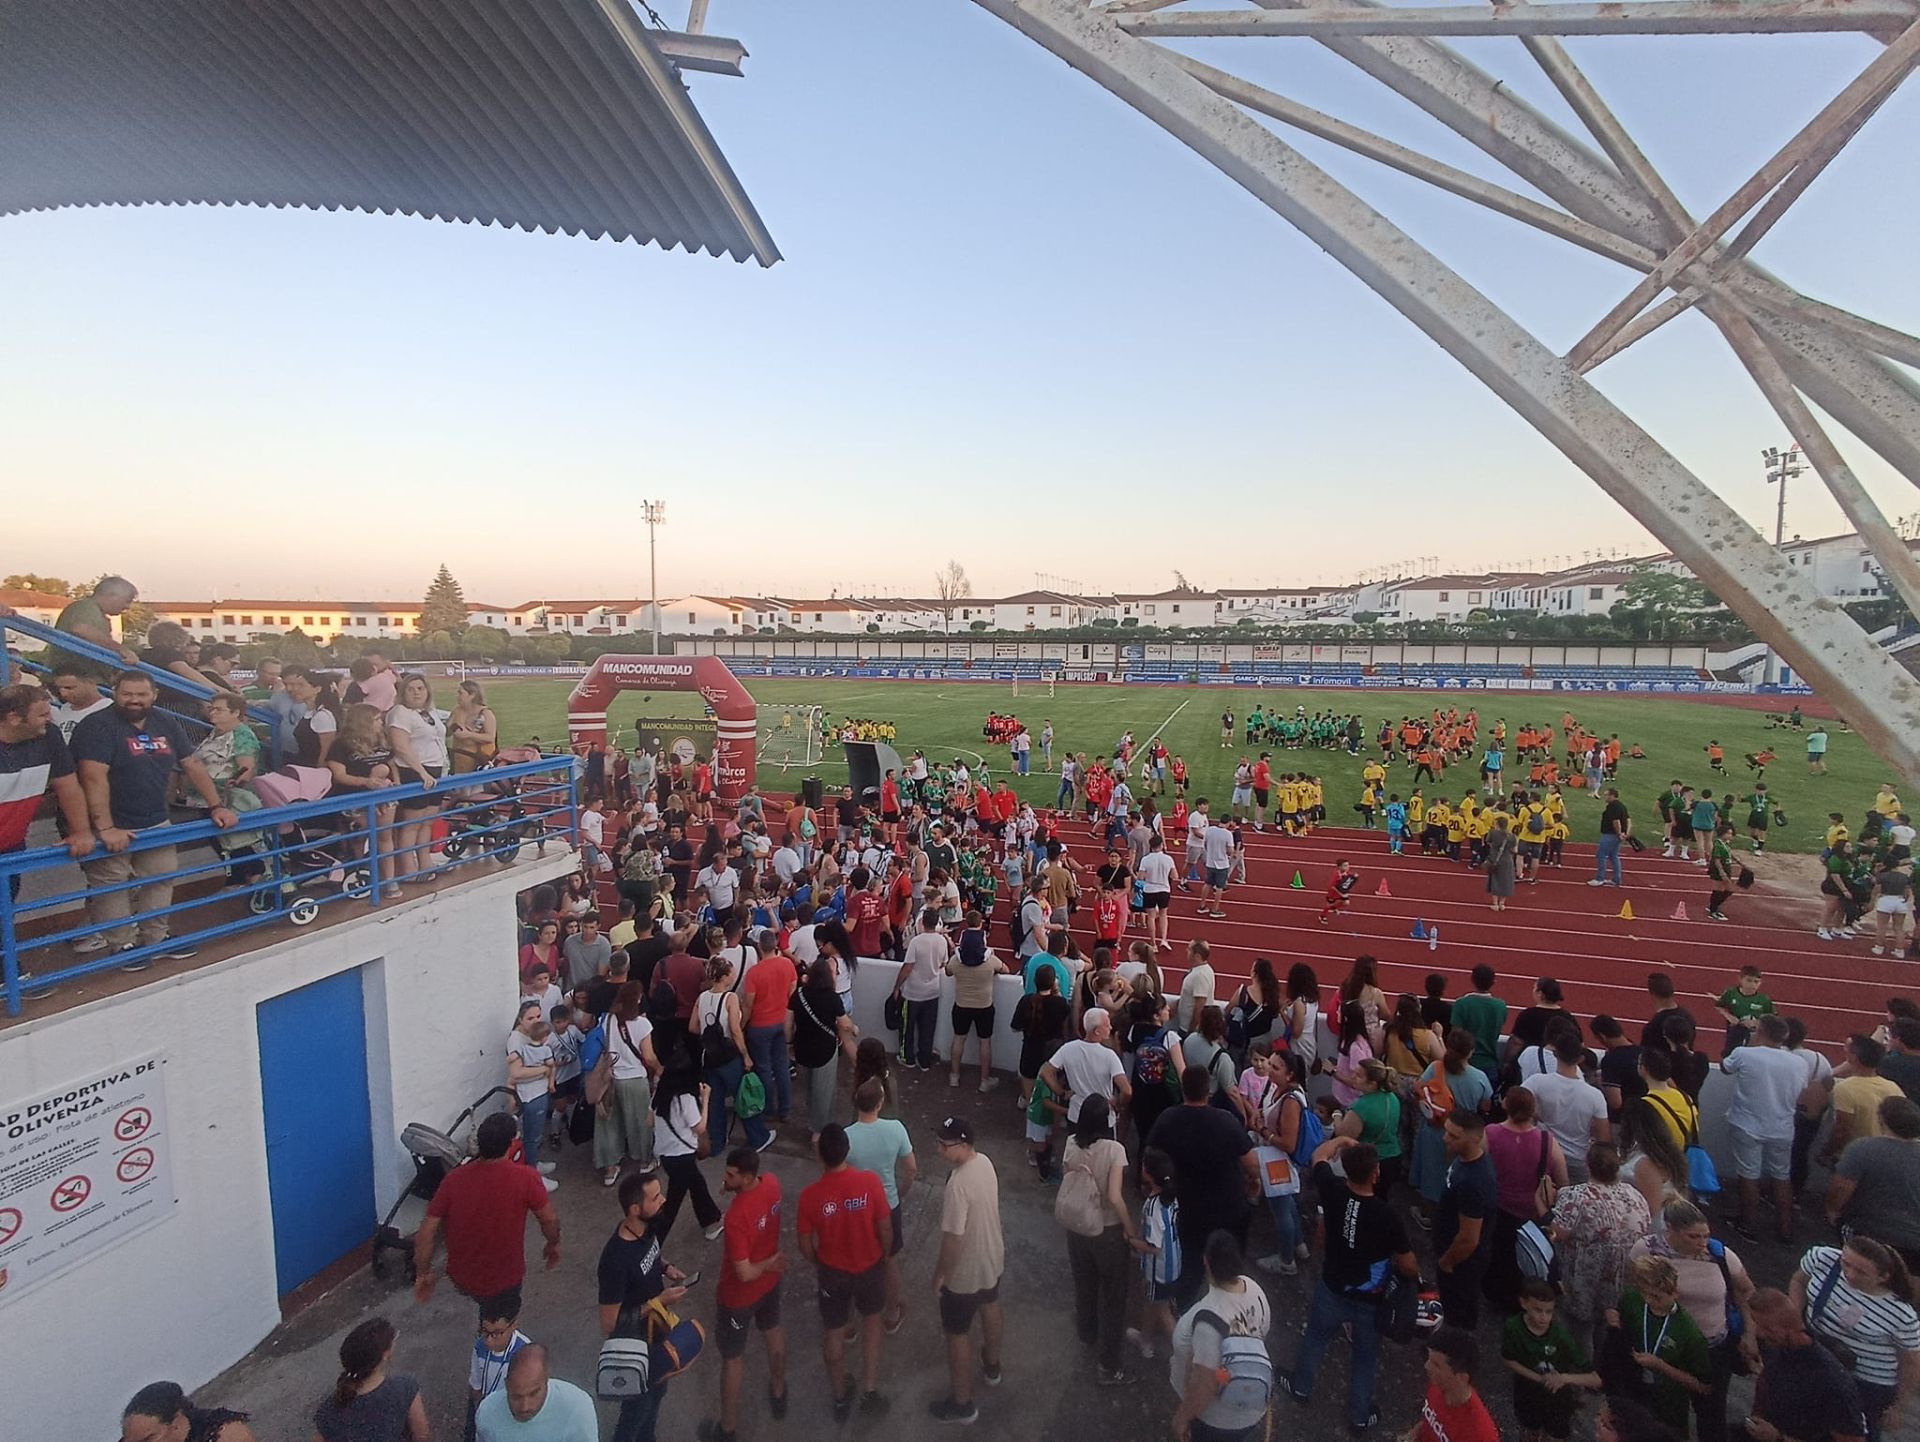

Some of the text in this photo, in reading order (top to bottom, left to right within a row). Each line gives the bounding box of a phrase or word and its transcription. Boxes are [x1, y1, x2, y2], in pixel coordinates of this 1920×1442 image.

[603, 663, 693, 676] MANCOMUNIDAD
[1313, 677, 1351, 685] infomovil
[641, 722, 694, 731] MANCOMUNIDAD
[1388, 808, 1401, 820] 13
[1428, 811, 1438, 823] 12
[1448, 820, 1460, 831] 20
[27, 1071, 131, 1118] DEPORTIVA
[135, 1060, 155, 1076] DE
[8, 1096, 104, 1139] OLIVENZA
